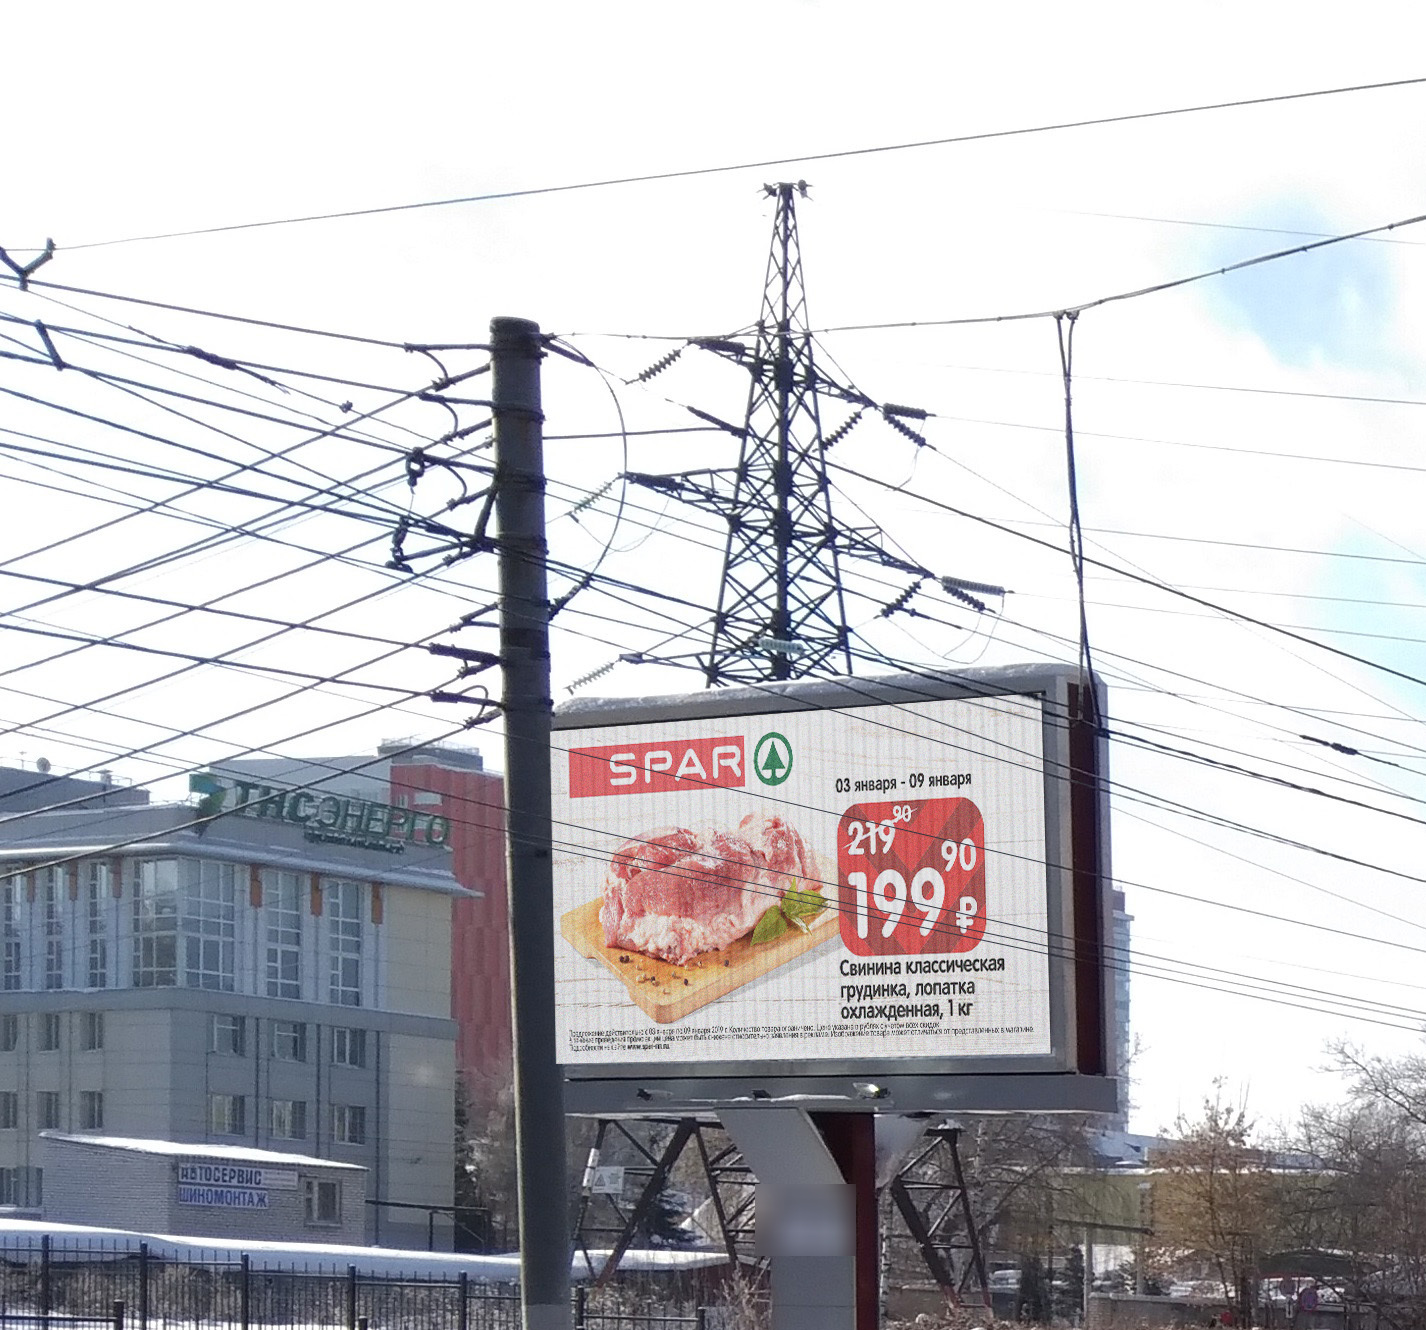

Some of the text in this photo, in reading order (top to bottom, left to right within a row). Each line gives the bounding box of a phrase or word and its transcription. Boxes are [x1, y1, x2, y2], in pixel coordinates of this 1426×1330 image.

[610, 745, 742, 786] SPAR
[835, 778, 851, 793] 03
[854, 778, 897, 794] января
[908, 773, 925, 789] 09
[928, 773, 972, 789] января
[847, 804, 912, 856] 219 90
[847, 837, 977, 940] 199 90
[839, 957, 1005, 977] Свинина классическая
[840, 980, 975, 1002] грудинка, лопатка
[840, 999, 973, 1021] охлажденная, 1 кг
[181, 1166, 262, 1186] АВТОСЕРВИС
[179, 1186, 267, 1208] ШИНОМОНТАЖ
